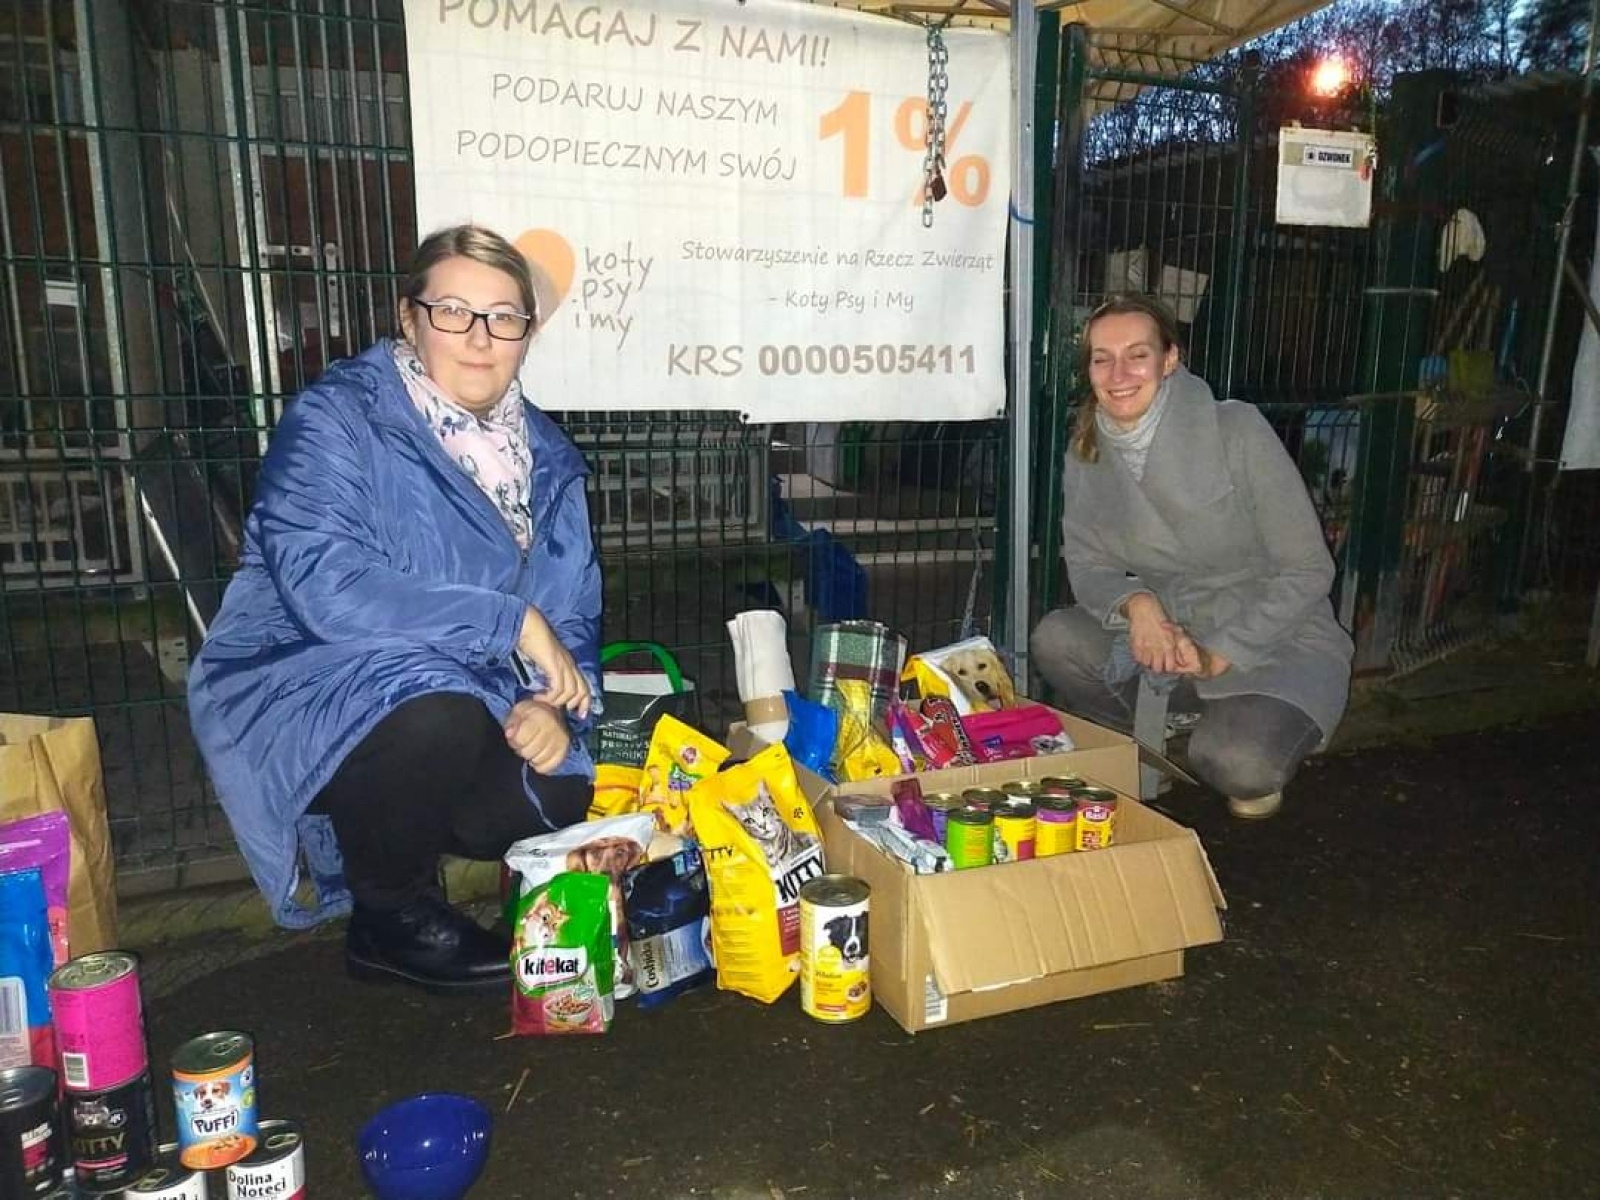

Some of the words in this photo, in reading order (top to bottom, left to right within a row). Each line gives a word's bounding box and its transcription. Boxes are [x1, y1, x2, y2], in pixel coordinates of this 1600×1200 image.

[438, 0, 655, 49] POMAGAJ
[673, 20, 702, 53] Z
[719, 26, 831, 68] NAMI!
[491, 72, 645, 113] PODARUJ
[656, 91, 779, 126] NASZYM
[456, 130, 707, 177] PODOPIECZNYM
[719, 150, 797, 182] SWÓJ
[818, 90, 991, 208] 1%
[584, 241, 654, 291] koty
[681, 240, 829, 267] Stowarzyszenie
[836, 250, 859, 268] na
[864, 249, 914, 268] Rzecz
[921, 249, 997, 271] Zwierząt
[582, 278, 632, 313] psy
[784, 290, 829, 314] Koty
[835, 290, 865, 314] Psy
[873, 291, 880, 309] i
[886, 291, 914, 314] My
[589, 312, 634, 351] my
[666, 344, 743, 377] KRS
[758, 343, 976, 377] 0000505411
[775, 856, 825, 903] KITTY
[524, 956, 580, 976] kitekat
[228, 1169, 273, 1186] Dolina
[236, 1177, 287, 1198] Noteci
